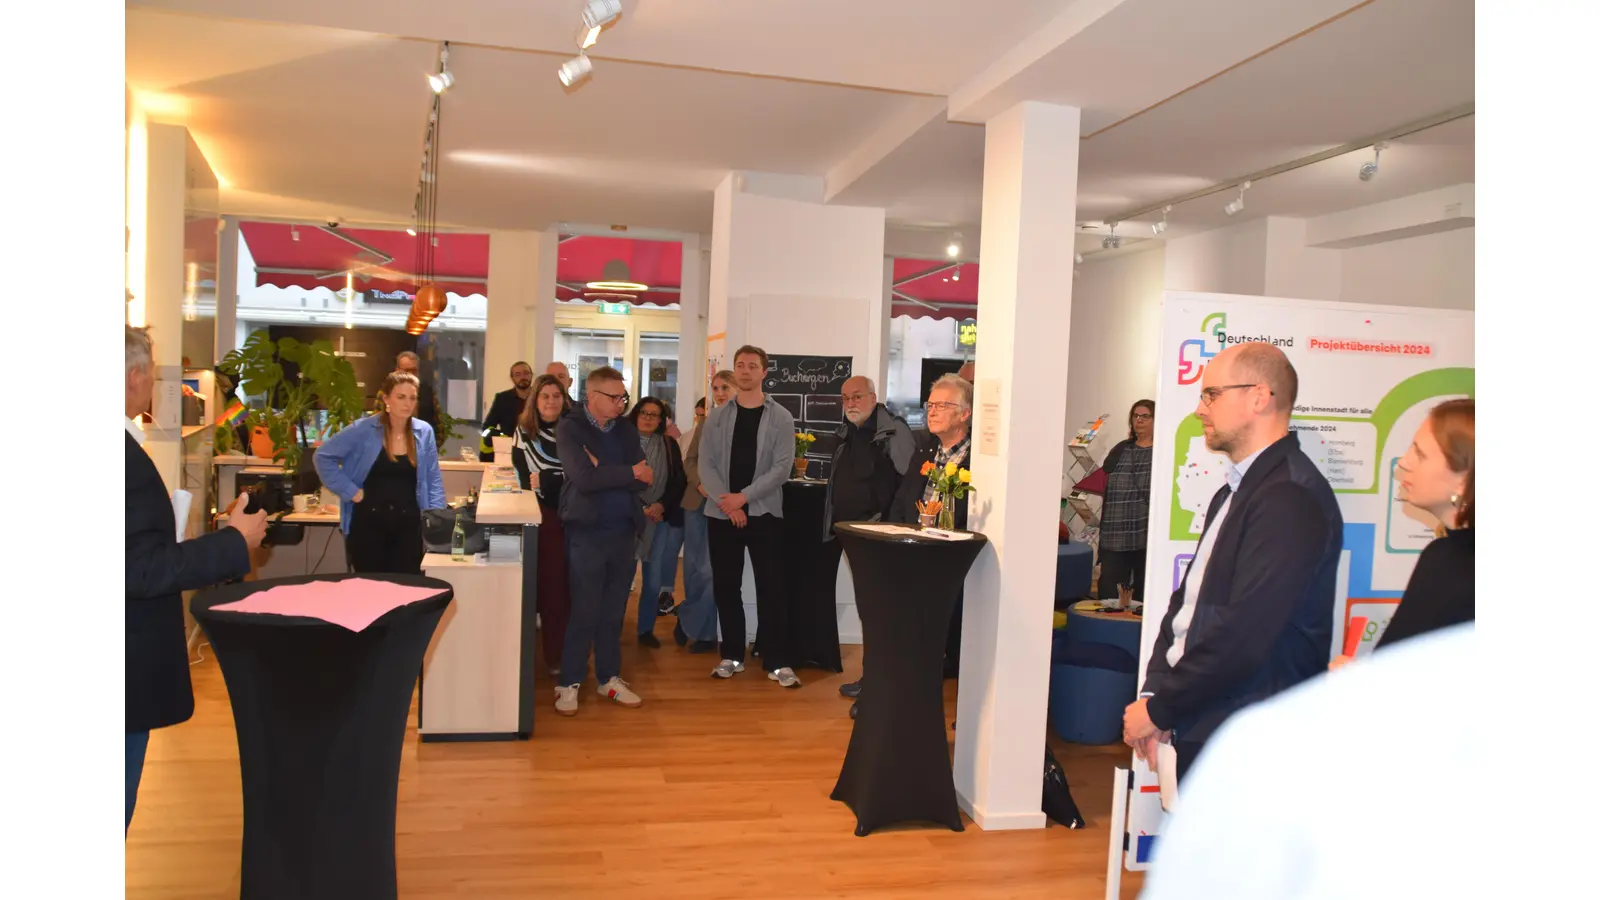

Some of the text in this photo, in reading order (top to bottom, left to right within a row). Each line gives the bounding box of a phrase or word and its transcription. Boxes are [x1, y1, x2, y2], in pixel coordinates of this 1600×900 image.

[1218, 332, 1294, 347] Deutschland
[1310, 339, 1431, 355] Projektübersicht 2024
